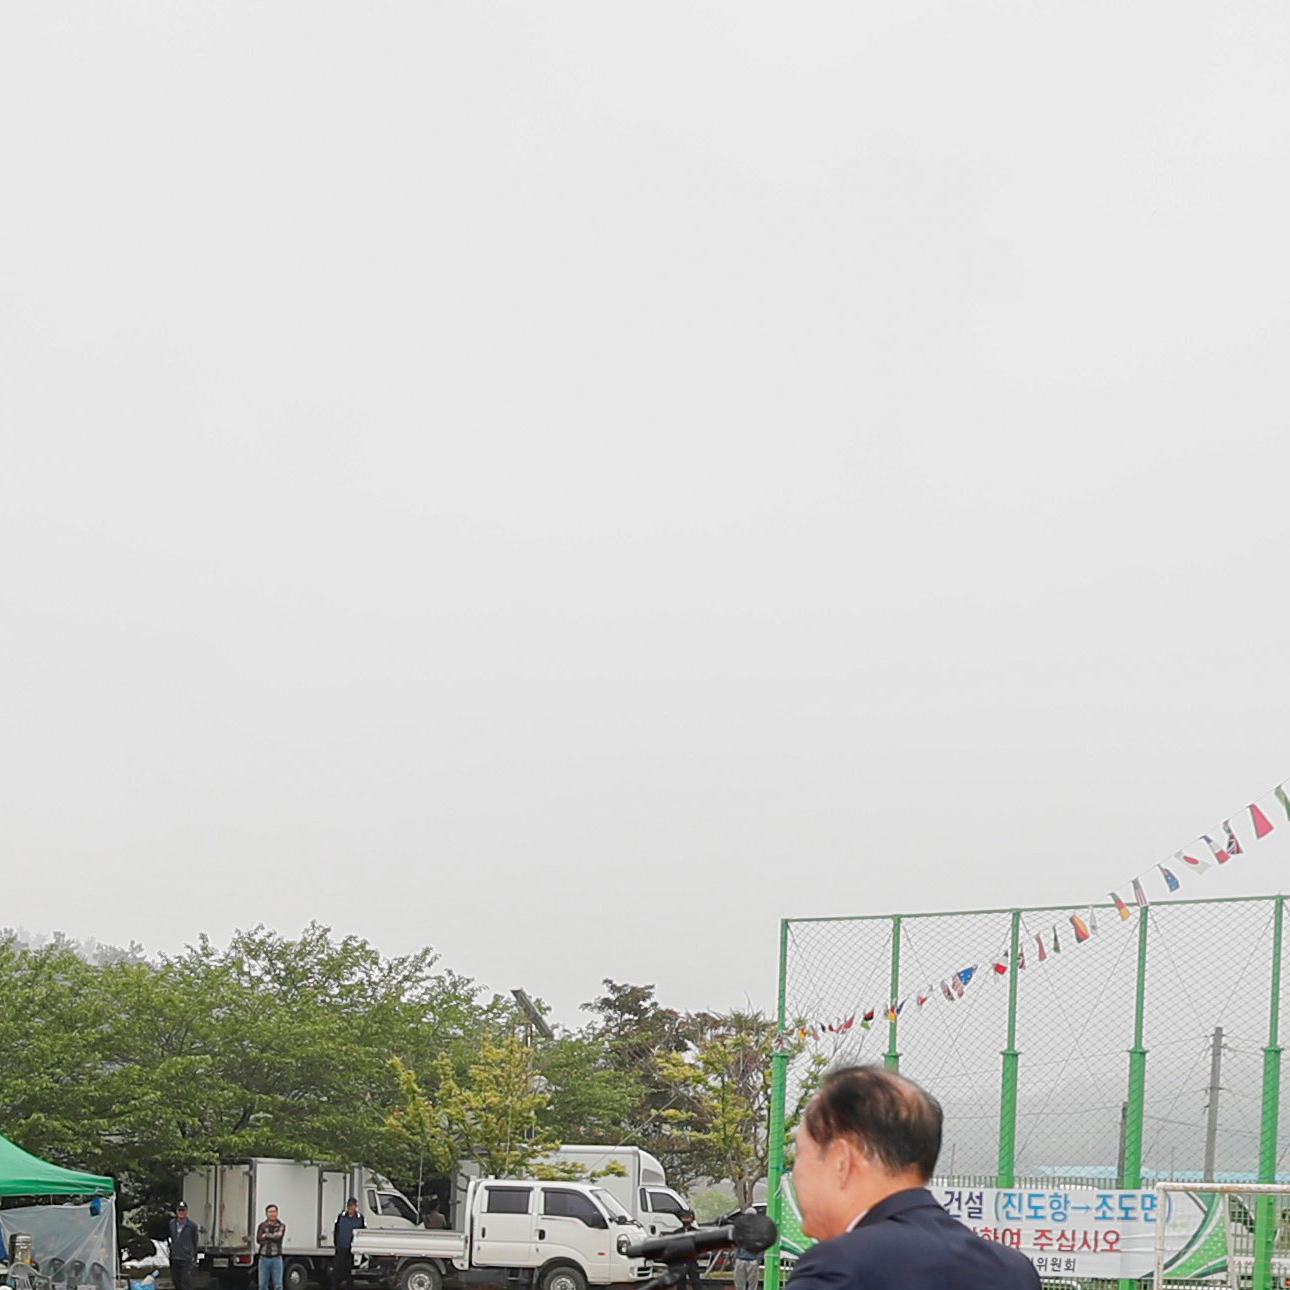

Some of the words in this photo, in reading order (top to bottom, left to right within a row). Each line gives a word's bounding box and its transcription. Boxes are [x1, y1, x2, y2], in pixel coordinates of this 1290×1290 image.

[944, 1191, 983, 1219] 건설
[1033, 1228, 1121, 1253] 주십시오
[1032, 1257, 1077, 1273] 위원회
